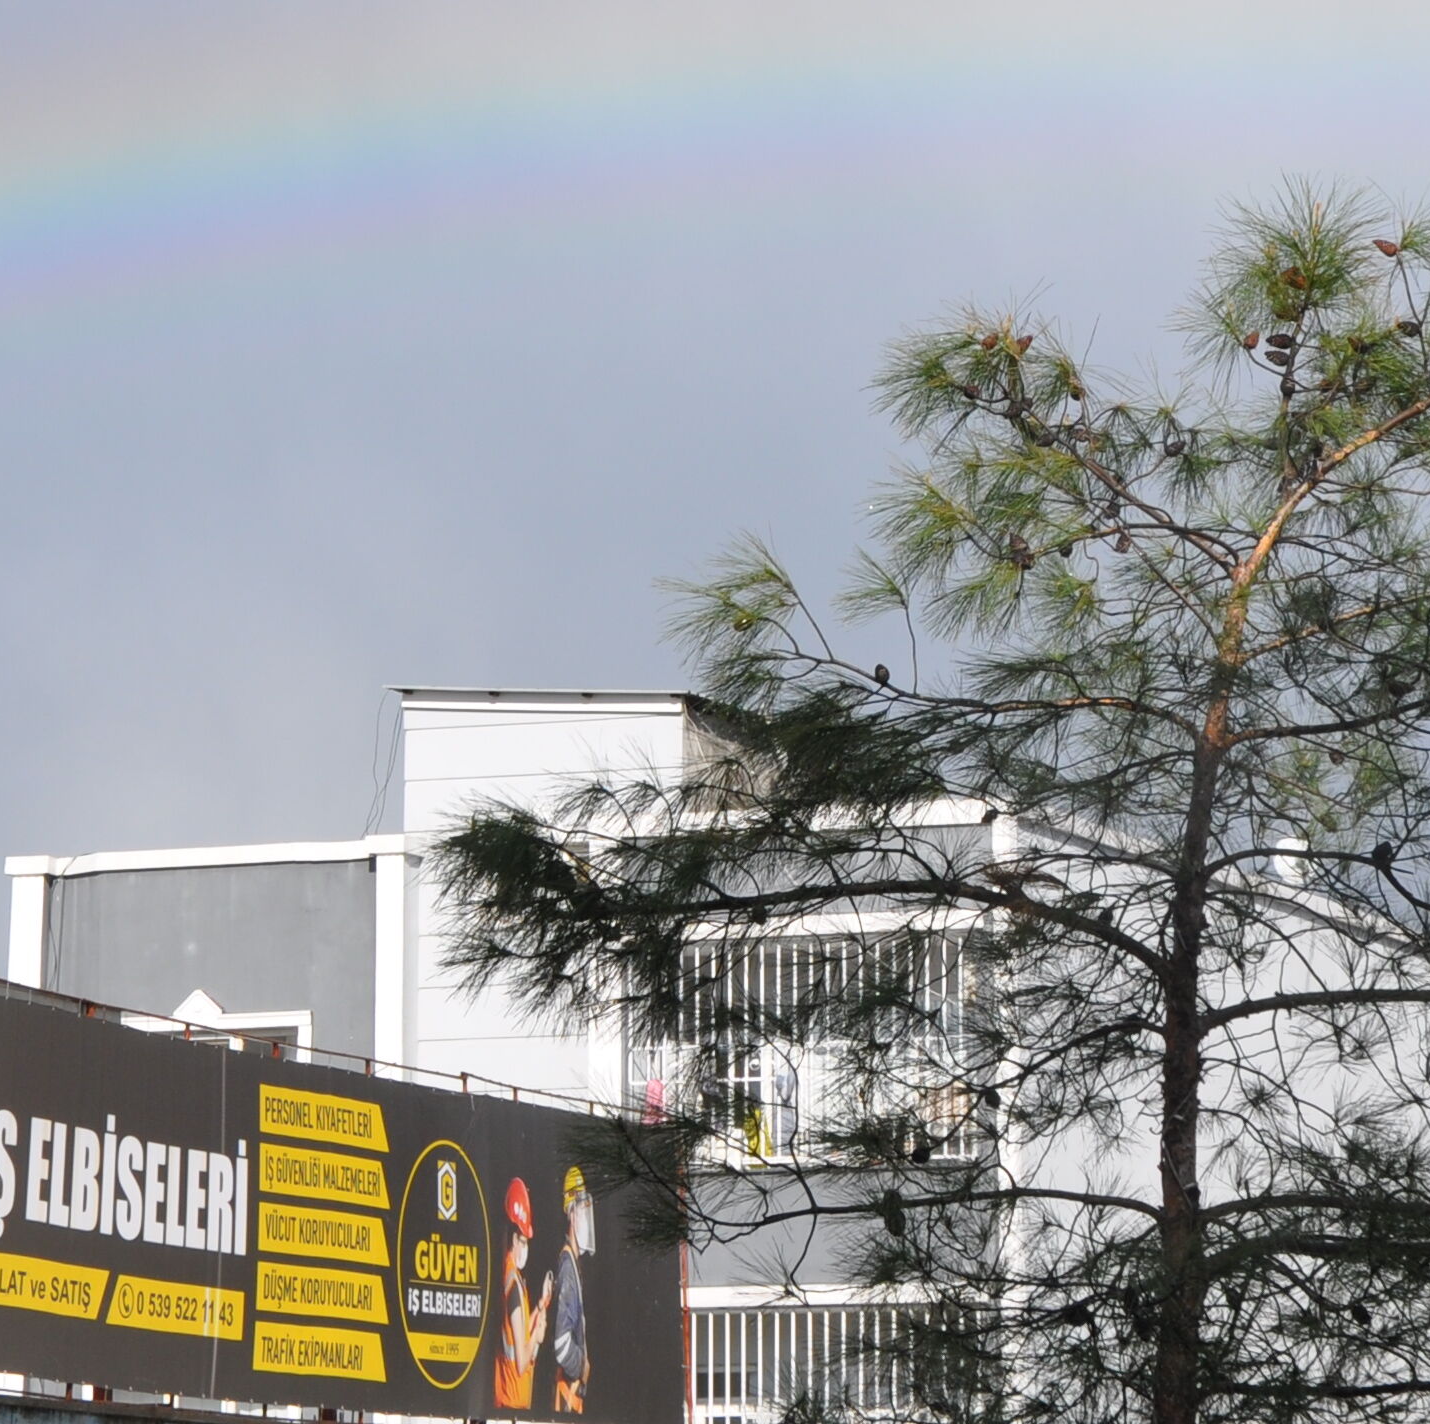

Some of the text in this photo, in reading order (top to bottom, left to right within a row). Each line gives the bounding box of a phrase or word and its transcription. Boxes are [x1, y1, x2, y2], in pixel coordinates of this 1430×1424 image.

[264, 1096, 372, 1139] PERSONEL KIYAFETLERİ
[25, 1113, 249, 1257] ELBİSELERİ
[265, 1149, 381, 1197] İŞ GÜVENLİĞİ MALZEMELERİ
[265, 1208, 371, 1252] VÜCUT KORUYUCULARI
[414, 1233, 478, 1284] GÜVEN
[30, 1278, 46, 1300] ve
[50, 1277, 92, 1314] SATIŞ
[136, 1290, 234, 1327] 0 539 522 11 43
[263, 1268, 373, 1311] DÜŞME KORUYUCULARI
[261, 1332, 364, 1372] TRAFİK EKİPMANLARI
